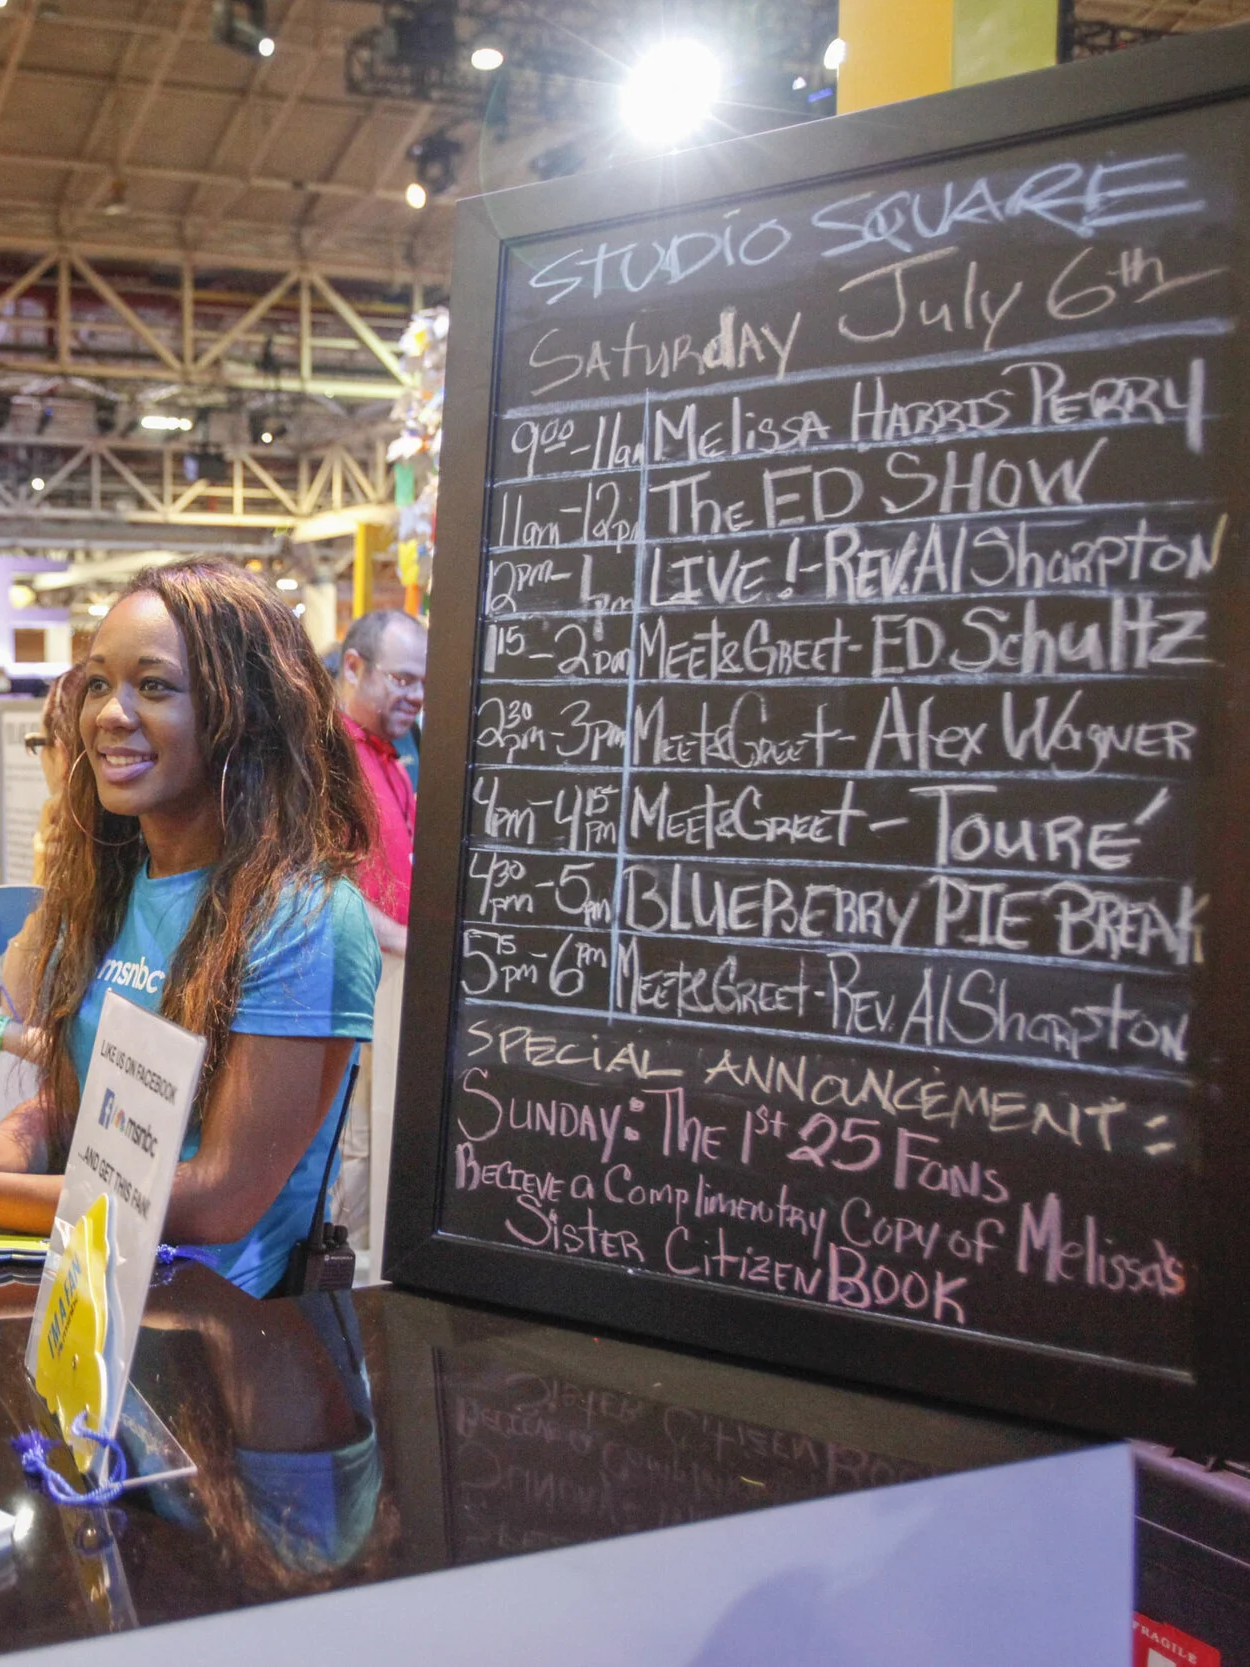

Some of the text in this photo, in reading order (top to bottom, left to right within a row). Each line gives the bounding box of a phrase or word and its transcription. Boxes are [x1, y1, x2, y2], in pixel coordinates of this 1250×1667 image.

[810, 153, 1205, 257] SQUARE
[838, 246, 1023, 352] July
[1003, 358, 1204, 454] PERRY
[763, 465, 863, 528] ED
[881, 437, 1108, 514] SHOW
[871, 614, 946, 679] ED
[866, 687, 989, 771] Alex
[623, 862, 919, 949] BLUEBERRY
[924, 874, 1031, 949] PIE
[1035, 880, 1210, 965] BREAK
[97, 956, 166, 993] msnbc
[100, 1040, 179, 1104] LIKE US ON FACEBOOK
[125, 1118, 159, 1157] msnbc
[788, 1112, 881, 1171] 25
[98, 1159, 115, 1184] GET
[114, 1172, 133, 1204] THIS
[570, 1174, 595, 1200] a
[949, 1218, 1005, 1264] of
[829, 1243, 967, 1324] BOOK
